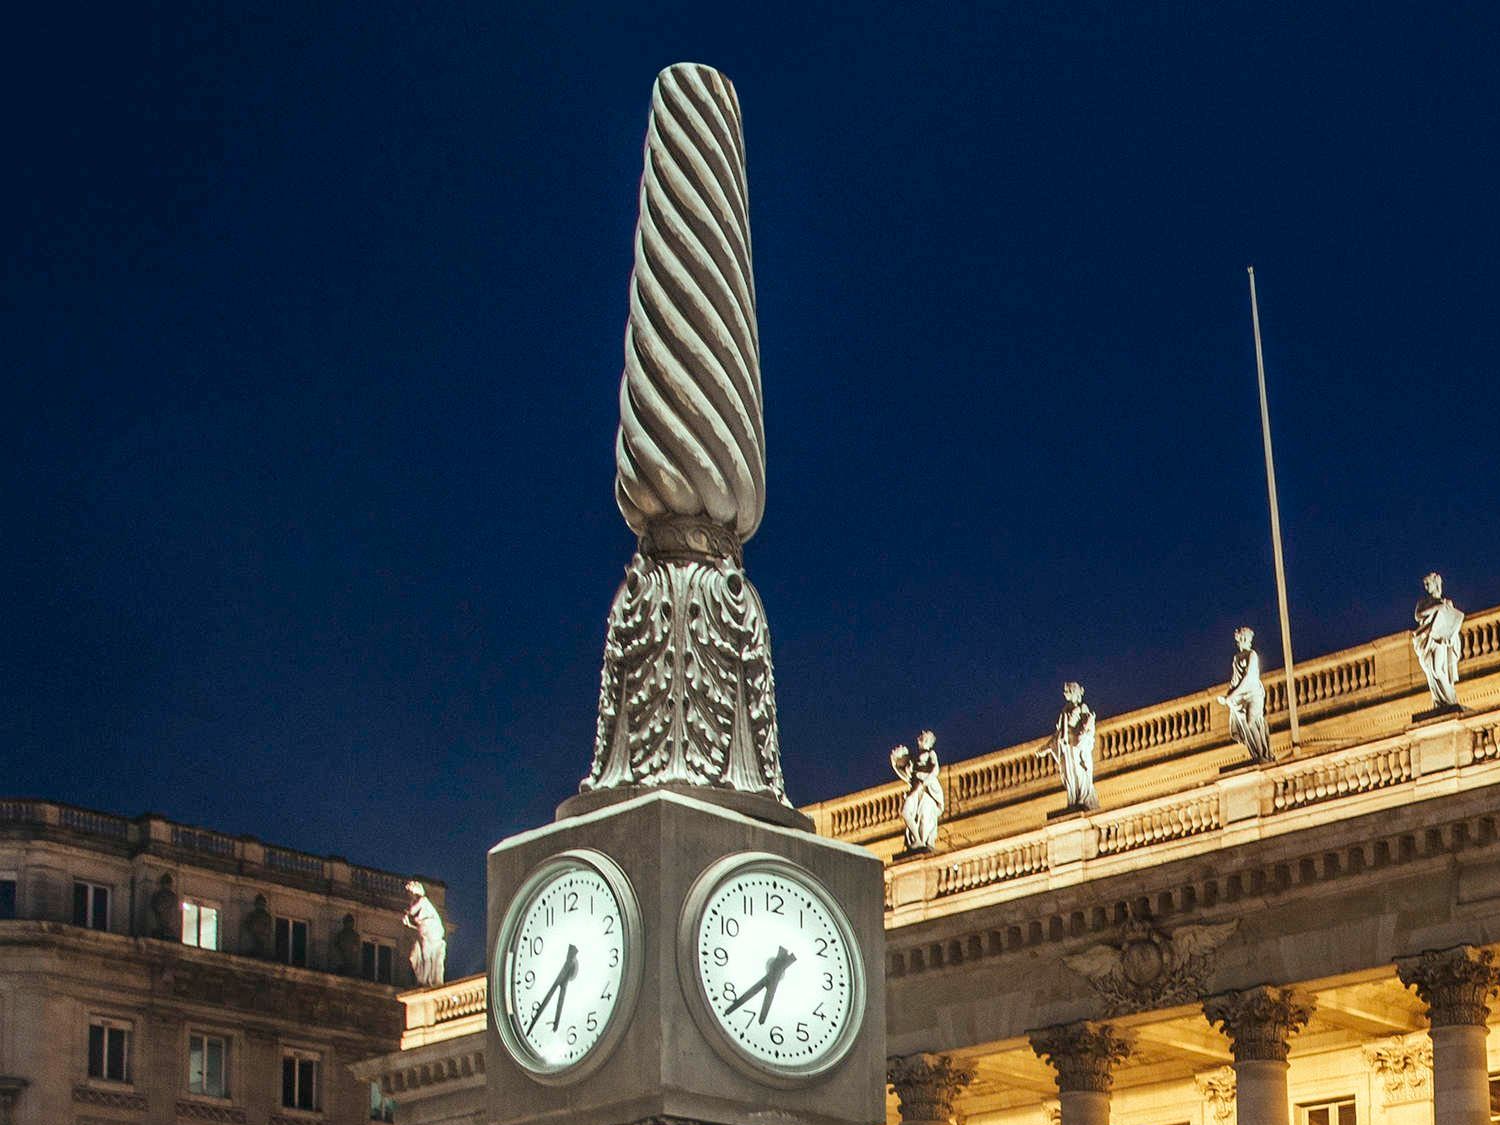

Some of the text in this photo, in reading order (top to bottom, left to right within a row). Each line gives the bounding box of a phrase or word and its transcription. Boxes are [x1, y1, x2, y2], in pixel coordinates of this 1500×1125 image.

[563, 892, 579, 913] 12
[743, 895, 753, 916] 11
[766, 892, 785, 915] 12
[545, 907, 554, 927] 11
[603, 915, 614, 935] 2
[720, 915, 739, 937] 10
[529, 936, 544, 958] 10
[713, 947, 729, 966] 9
[815, 938, 828, 958] 2
[608, 948, 619, 968] 3
[524, 970, 536, 990] 9
[823, 972, 833, 991] 3
[600, 981, 612, 1001] 4
[722, 981, 737, 1002] 8
[587, 1011, 598, 1032] 5
[743, 1009, 756, 1029] 7
[812, 1002, 827, 1021] 4
[566, 1025, 577, 1045] 6
[770, 1026, 785, 1046] 6
[796, 1022, 810, 1042] 5
